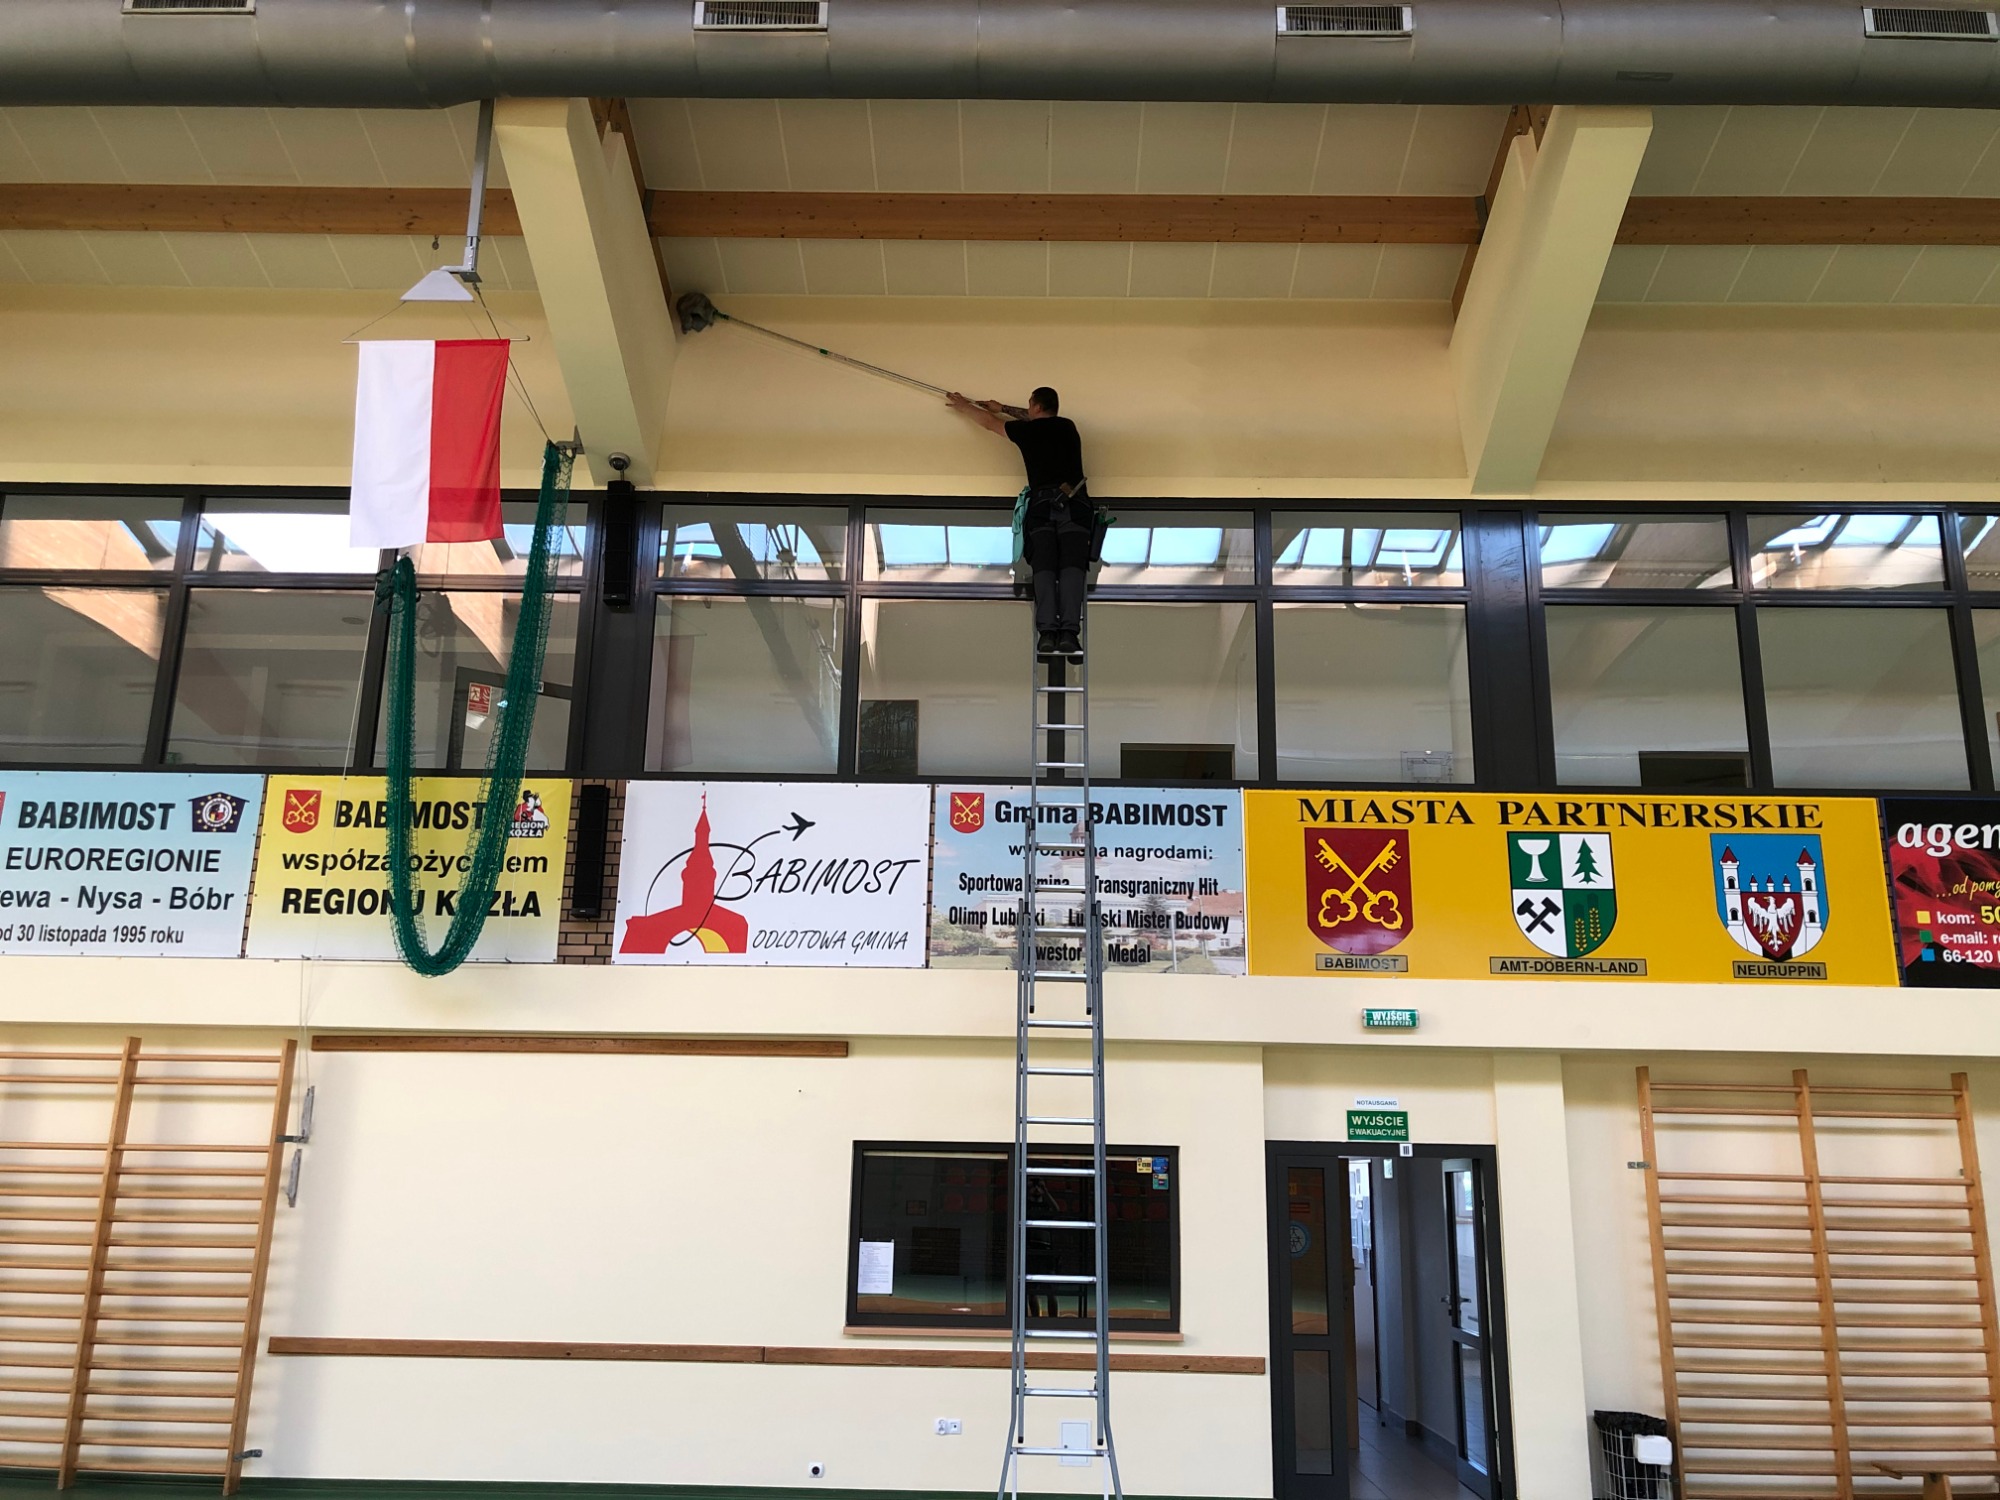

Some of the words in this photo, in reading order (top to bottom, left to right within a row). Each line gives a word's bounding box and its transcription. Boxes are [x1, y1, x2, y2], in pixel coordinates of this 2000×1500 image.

[18, 801, 176, 830] BABIMOST
[334, 800, 488, 829] BABMOST
[995, 801, 1077, 824] Gmina
[1089, 802, 1227, 827] BABIMOST
[1298, 799, 1475, 825] MIASTA
[1497, 800, 1824, 829] PARTNERSKIE
[5, 847, 222, 873] EUROREGIONIE
[1115, 845, 1213, 862] nagrodami:
[714, 846, 921, 901] BABIMOST
[959, 873, 1023, 895] Sportowa
[1199, 878, 1218, 896] Hit
[0, 890, 51, 908] ewa
[77, 886, 142, 915] Nysa
[169, 886, 234, 910] Bóbr
[435, 890, 541, 917] KZŁA
[949, 906, 988, 929] Olimp
[992, 908, 1045, 926] Lubki
[1068, 909, 1121, 928] Luski
[1126, 910, 1172, 930] Mister
[1176, 911, 1230, 934] Budowy
[1936, 911, 1976, 924] kom:
[17, 924, 35, 942] 30
[38, 925, 107, 946] listopada
[112, 926, 146, 943] 1995
[150, 926, 184, 943] roku
[752, 929, 847, 949] ODLOTOWA
[851, 930, 909, 954] GMINA
[1940, 932, 1988, 944] e-mail:
[1028, 943, 1083, 961] westor
[1108, 944, 1151, 963] Medal
[1324, 957, 1400, 970] BABIMOST
[1943, 949, 1993, 963] 66-120
[1737, 964, 1821, 977] NEURUPPIN
[1351, 1114, 1405, 1127] WYJŚCIE
[1350, 1128, 1407, 1137] EWAKUACYJNE
